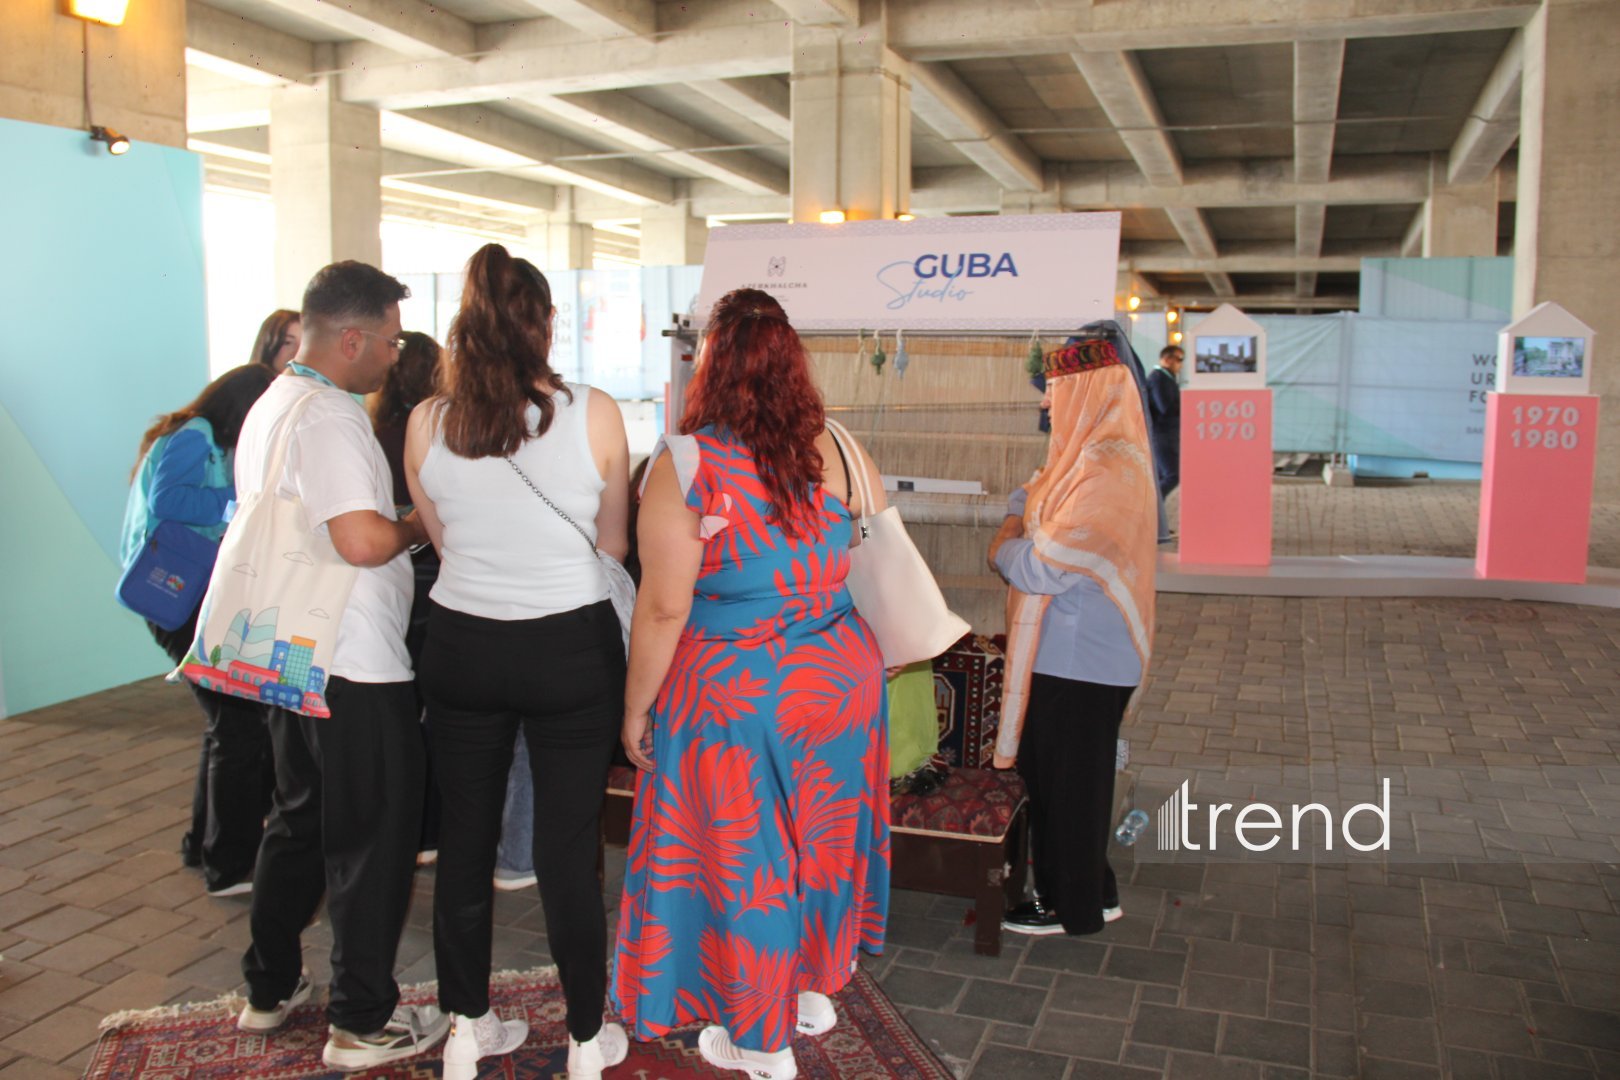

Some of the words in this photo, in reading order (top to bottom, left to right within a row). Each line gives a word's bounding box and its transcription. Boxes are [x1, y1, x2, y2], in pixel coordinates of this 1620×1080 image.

[914, 253, 1018, 279] GUBA
[876, 260, 974, 310] Studio
[1195, 400, 1256, 419] 1960
[1513, 405, 1579, 427] 1970
[1195, 421, 1256, 441] 1970
[1511, 428, 1578, 449] 1980
